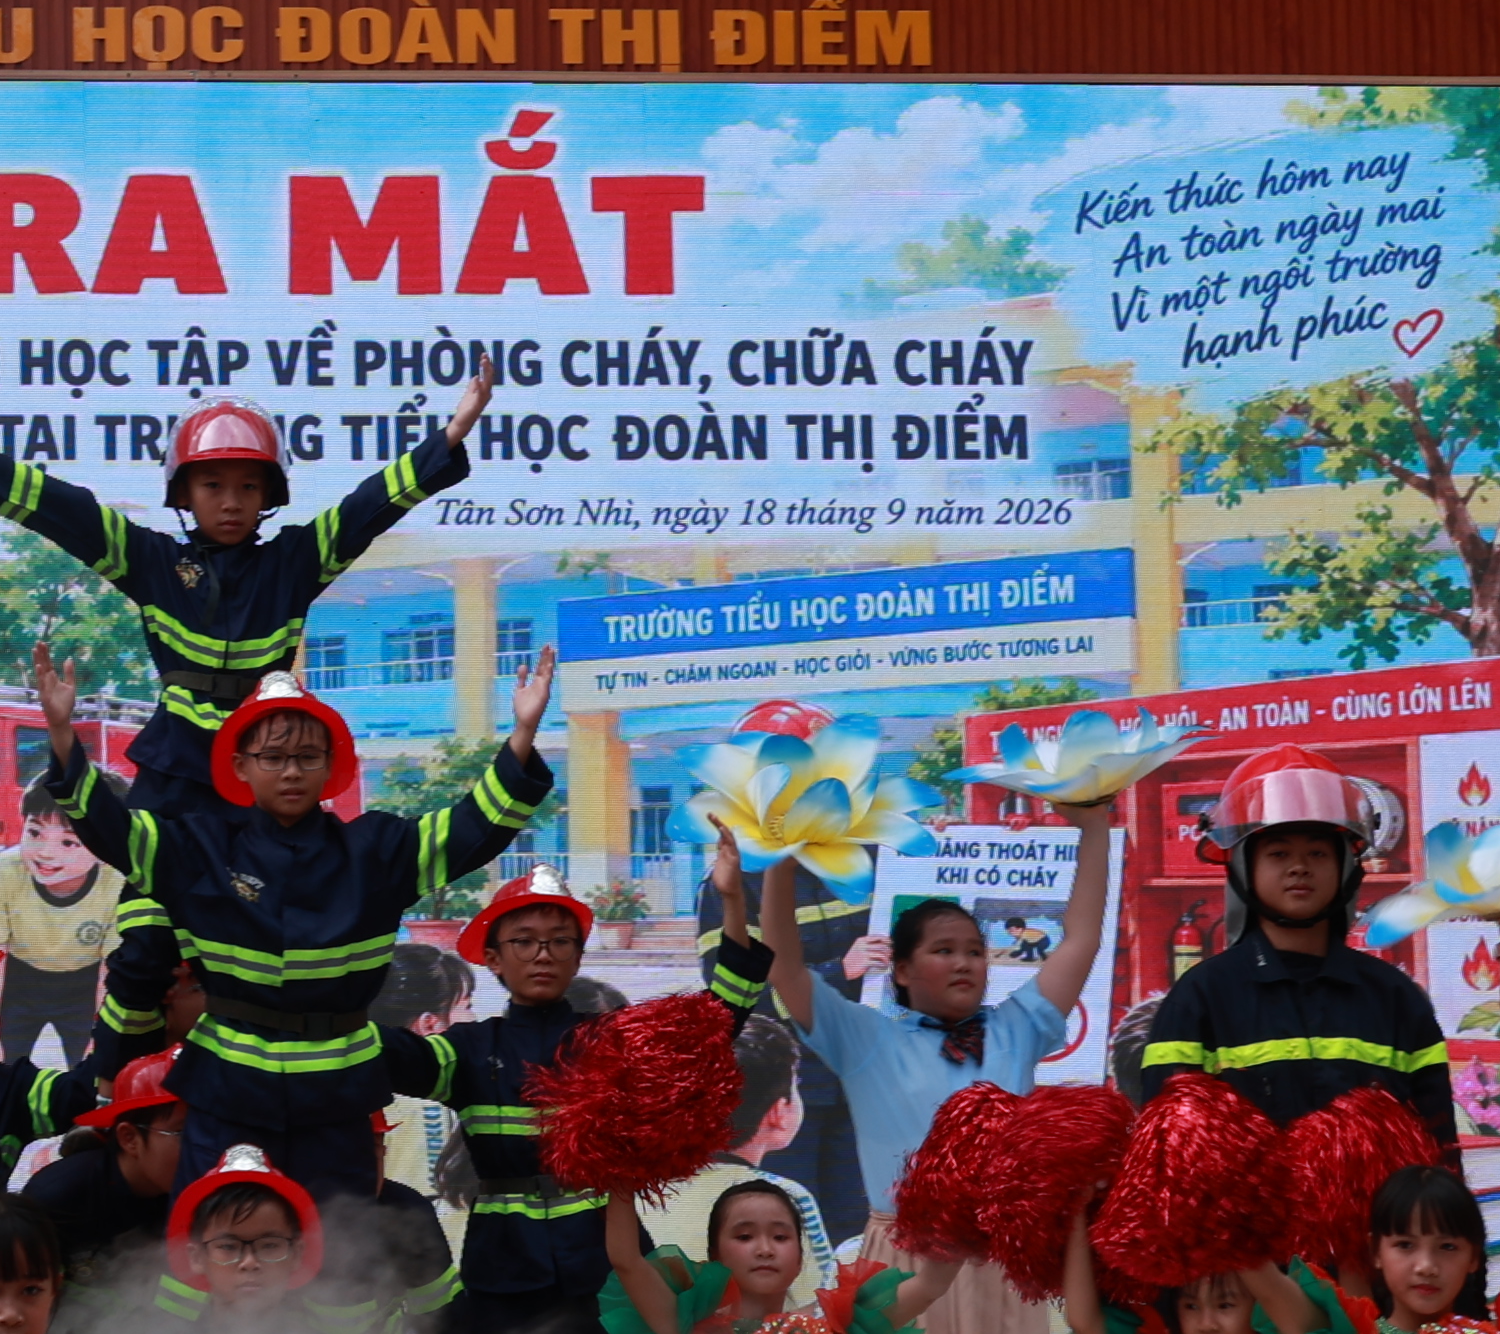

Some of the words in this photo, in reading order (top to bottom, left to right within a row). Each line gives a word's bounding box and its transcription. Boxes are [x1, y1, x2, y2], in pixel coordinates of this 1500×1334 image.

[71, 5, 245, 72] HỌC
[549, 8, 682, 73] THỊ
[287, 109, 706, 296] MẮT
[1074, 181, 1155, 235] Kiến
[1164, 171, 1244, 217] thức
[1256, 157, 1331, 200] hôm
[1342, 151, 1412, 190] nay
[1112, 232, 1171, 278] An
[1180, 219, 1263, 262] toàn
[1275, 202, 1365, 254] ngày
[1376, 186, 1446, 228] mai
[1111, 283, 1151, 333] Vì
[1160, 272, 1232, 317] một
[1239, 258, 1316, 311] ngôi
[1325, 239, 1443, 289] trường
[20, 337, 130, 398] HỌC
[148, 325, 250, 398] TẬP
[267, 319, 336, 387] VỀ
[353, 325, 543, 387] PHÒNG
[560, 324, 713, 396] CHÁY,
[728, 327, 877, 387] CHỮA
[892, 325, 1036, 387] CHÁY
[1181, 312, 1282, 371] hạnh
[1291, 294, 1390, 361] phúc
[481, 413, 590, 473] HỌC
[611, 401, 776, 462] ĐOÀN
[787, 413, 874, 473] THỊ
[893, 393, 1029, 462] ĐIỂM
[435, 498, 505, 527] Tân
[511, 498, 570, 528] Sơn
[578, 496, 642, 532] Nhì,
[650, 497, 730, 536] ngày
[740, 498, 776, 527] 18
[785, 495, 874, 536] tháng
[884, 498, 906, 528] 9
[914, 498, 985, 527] năm
[996, 497, 1073, 527] 2026
[604, 604, 714, 644] TRƯỜNG
[718, 589, 781, 636] TIỂU
[790, 594, 848, 633] HỌC
[856, 584, 936, 622] ĐOÀN
[942, 579, 991, 619] THỊ
[997, 560, 1077, 609] ĐIỂM
[594, 670, 617, 694] TỰ
[622, 669, 648, 689] TIN
[717, 659, 778, 683] NGOAN
[793, 655, 832, 681] HỌC
[834, 649, 872, 676] GIỎI
[942, 637, 994, 664] BƯỚC
[996, 635, 1062, 660] TƯƠNG
[1065, 634, 1093, 655] LAI
[1219, 704, 1248, 732] AN
[1252, 694, 1311, 729] TOÀN
[1331, 687, 1393, 722] CÙNG
[1398, 680, 1444, 716] LỚN
[1449, 676, 1493, 713] LÊN
[936, 866, 969, 885] KHI
[974, 864, 1001, 885] CÓ
[1007, 866, 1059, 888] CHÁY
[987, 839, 1050, 860] THOÁT
